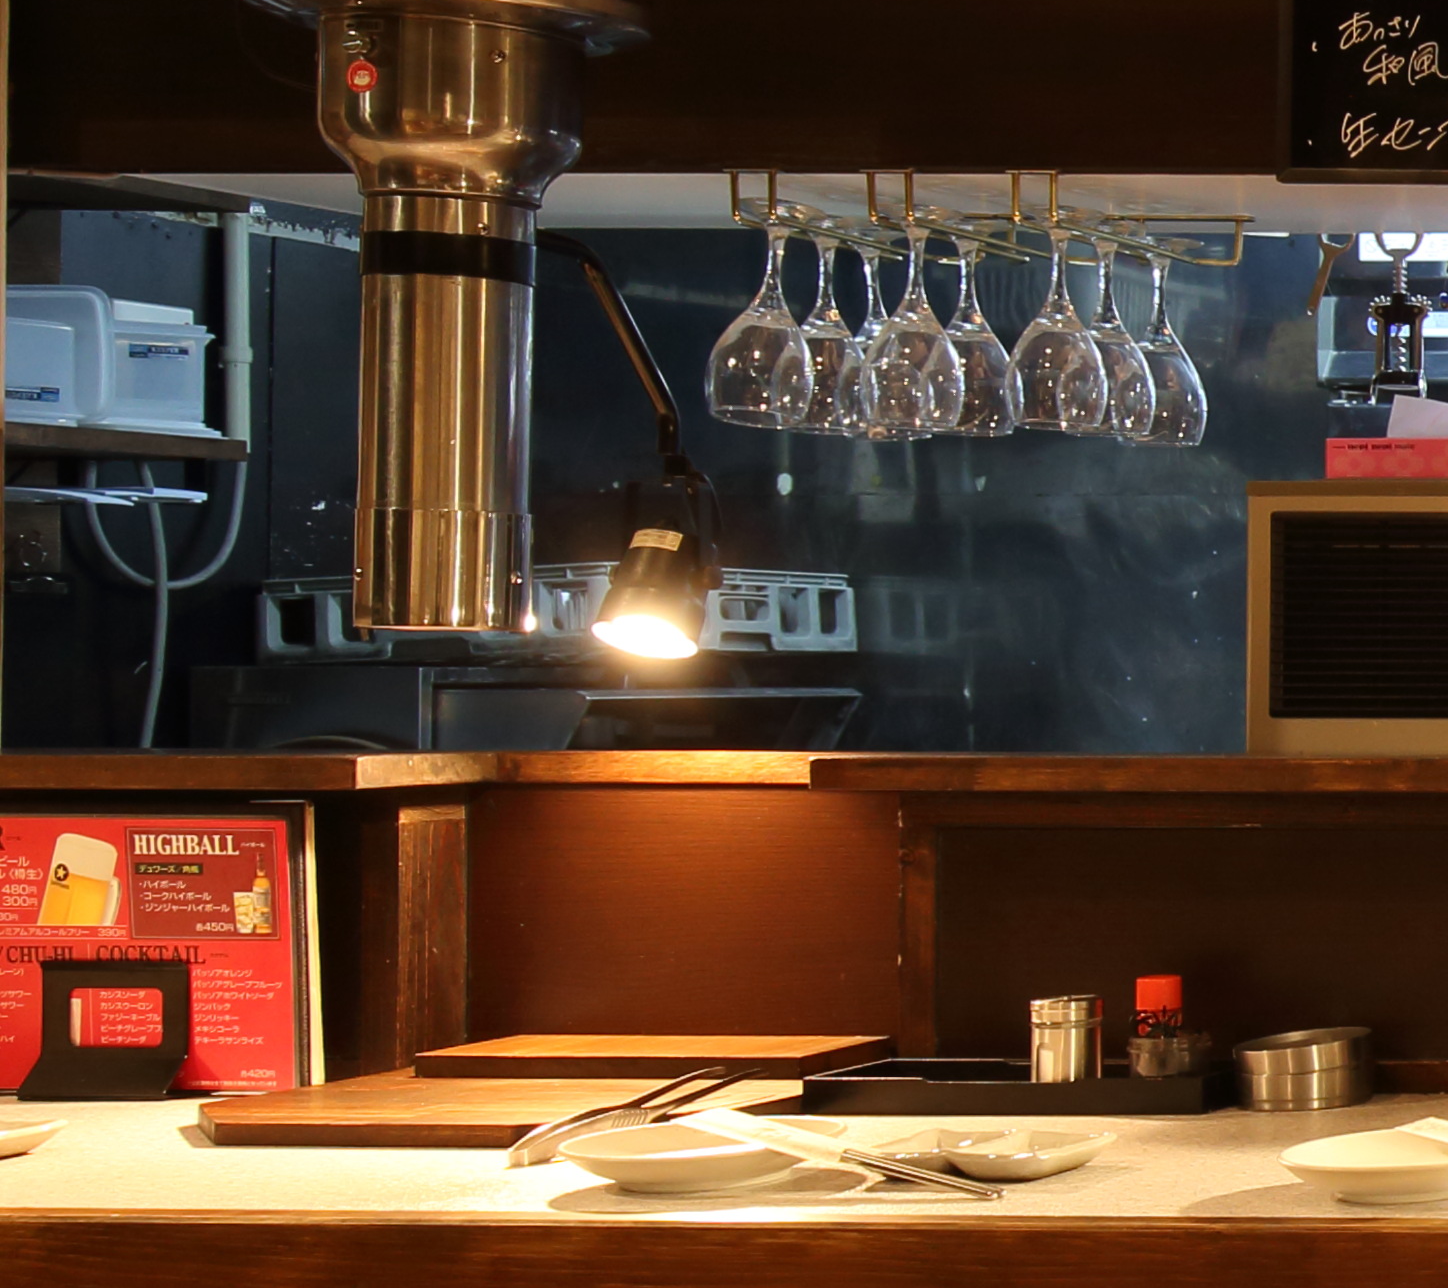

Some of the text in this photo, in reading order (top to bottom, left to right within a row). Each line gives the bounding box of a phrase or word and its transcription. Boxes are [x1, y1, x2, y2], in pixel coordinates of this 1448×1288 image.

[133, 834, 240, 856] HIGHBALL
[1, 884, 37, 895] 480円
[2, 896, 38, 907] 300円
[96, 945, 206, 964] COCKTAIL
